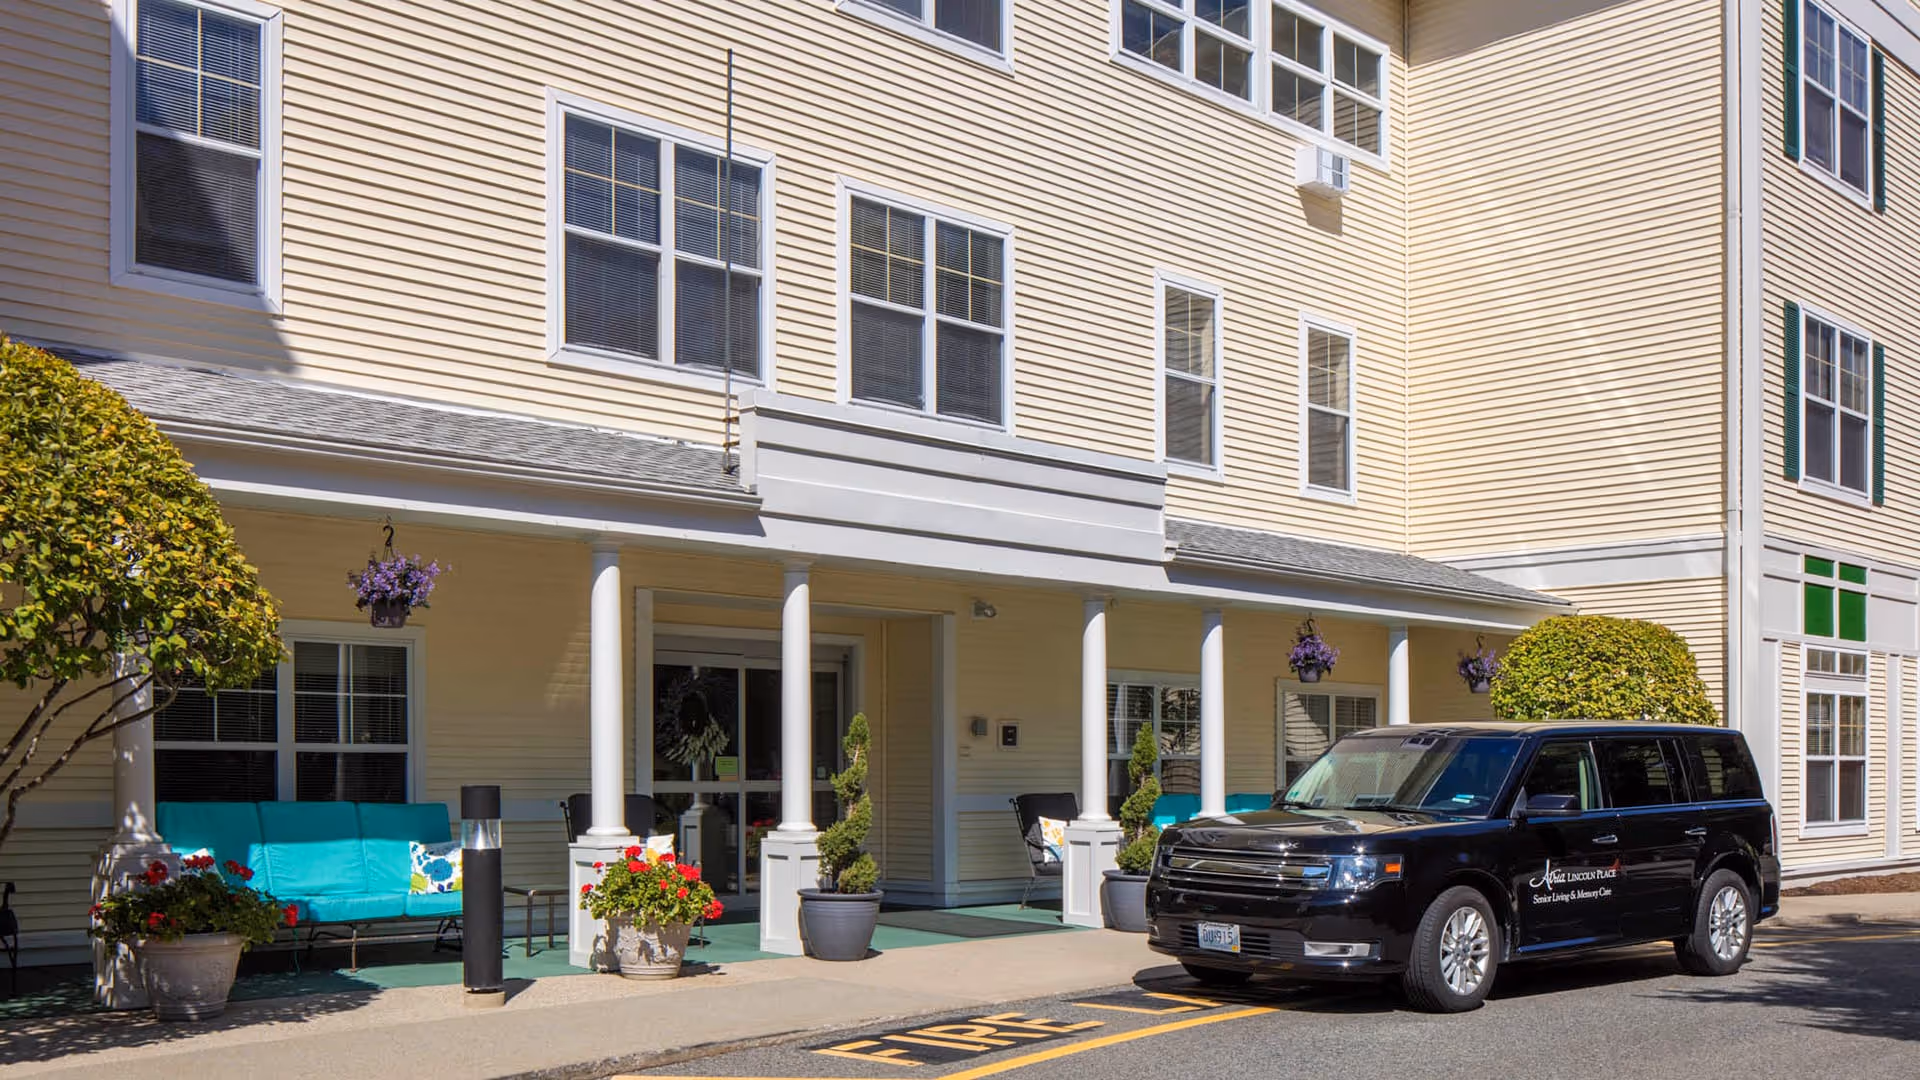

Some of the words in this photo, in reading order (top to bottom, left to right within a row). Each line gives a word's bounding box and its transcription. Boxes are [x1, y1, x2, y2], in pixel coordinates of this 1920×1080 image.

[1567, 871, 1596, 882] LINCOLN
[1596, 869, 1617, 879] PLACE
[1533, 894, 1552, 904] Senior
[1552, 892, 1570, 902] Living
[1570, 890, 1577, 900] &
[1577, 889, 1599, 899] Memory
[1599, 887, 1612, 897] Care
[811, 1012, 1105, 1066] FIRE
